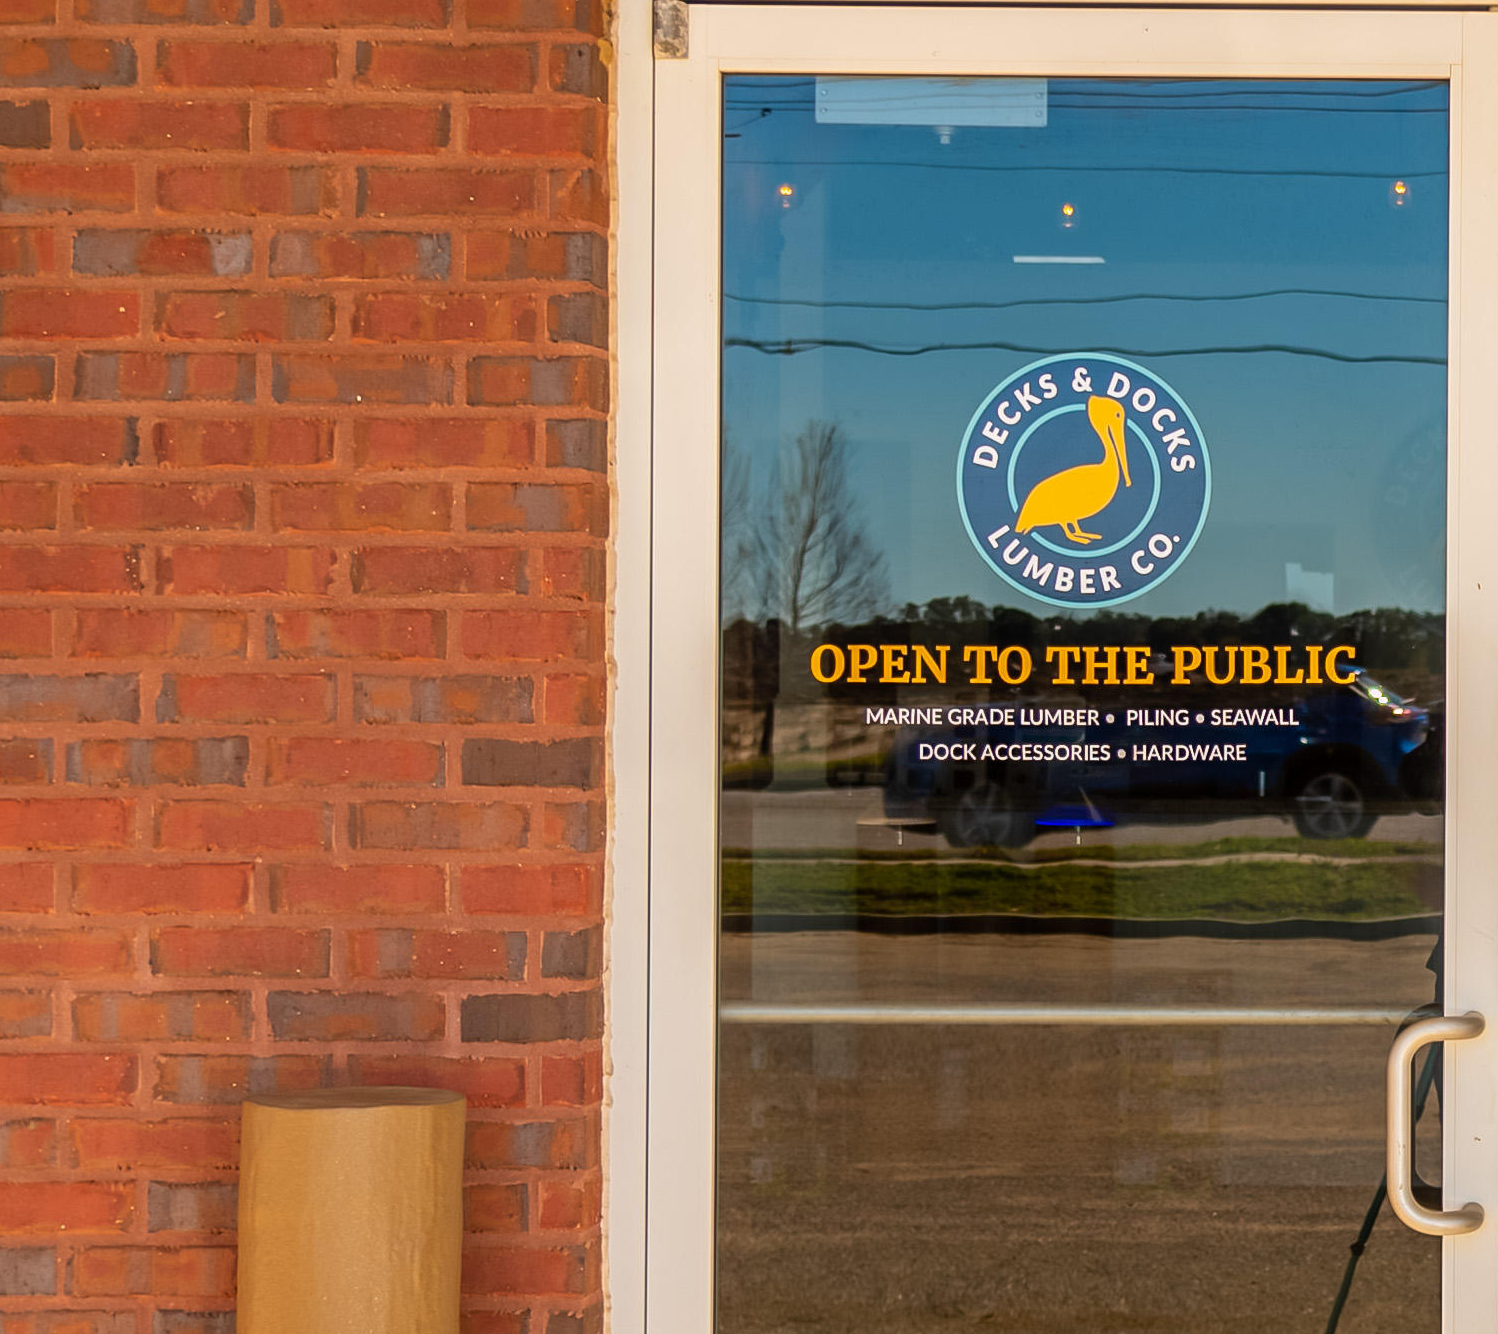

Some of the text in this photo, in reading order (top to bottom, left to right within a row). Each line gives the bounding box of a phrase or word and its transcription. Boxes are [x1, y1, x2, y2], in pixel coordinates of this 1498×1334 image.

[972, 366, 1196, 473] DECKS & DOCKS
[987, 524, 1181, 594] LUMBER CO.
[809, 643, 1357, 686] OPEN TO THE PUBLIC
[865, 707, 1300, 727] MARINE GRADE LUMBER PILING SEAWALL
[918, 743, 1248, 762] DOCK ACCESSORIES HARDWARE
